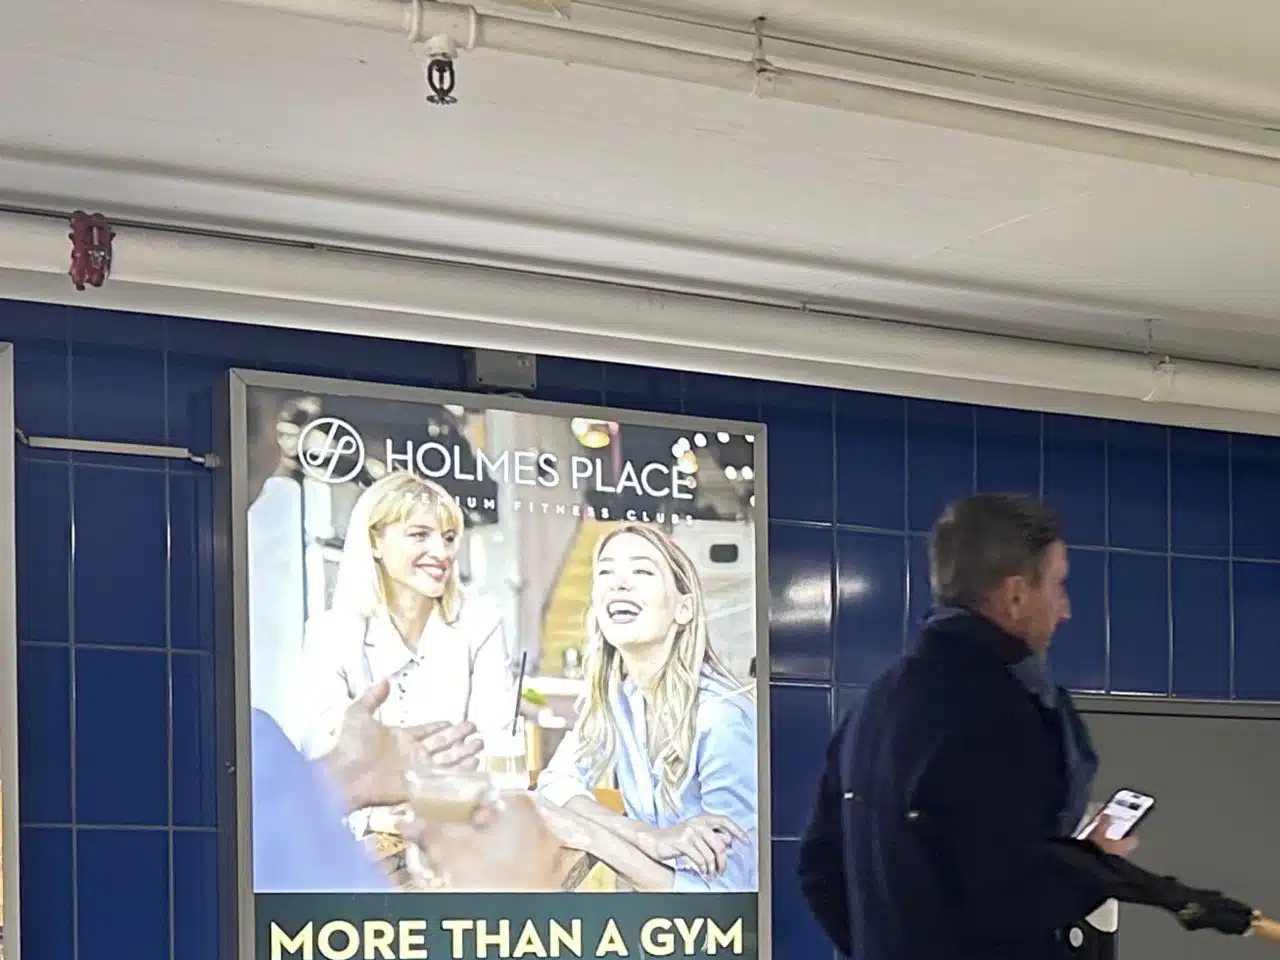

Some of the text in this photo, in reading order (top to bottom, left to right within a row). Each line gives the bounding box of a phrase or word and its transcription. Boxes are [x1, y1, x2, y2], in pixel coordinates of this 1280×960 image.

[386, 438, 694, 500] HOLMES PLACE
[514, 501, 610, 520] FITNESS
[626, 510, 694, 527] CLUBS
[441, 918, 582, 959] THAN
[595, 917, 629, 958] A
[640, 917, 744, 956] GYM
